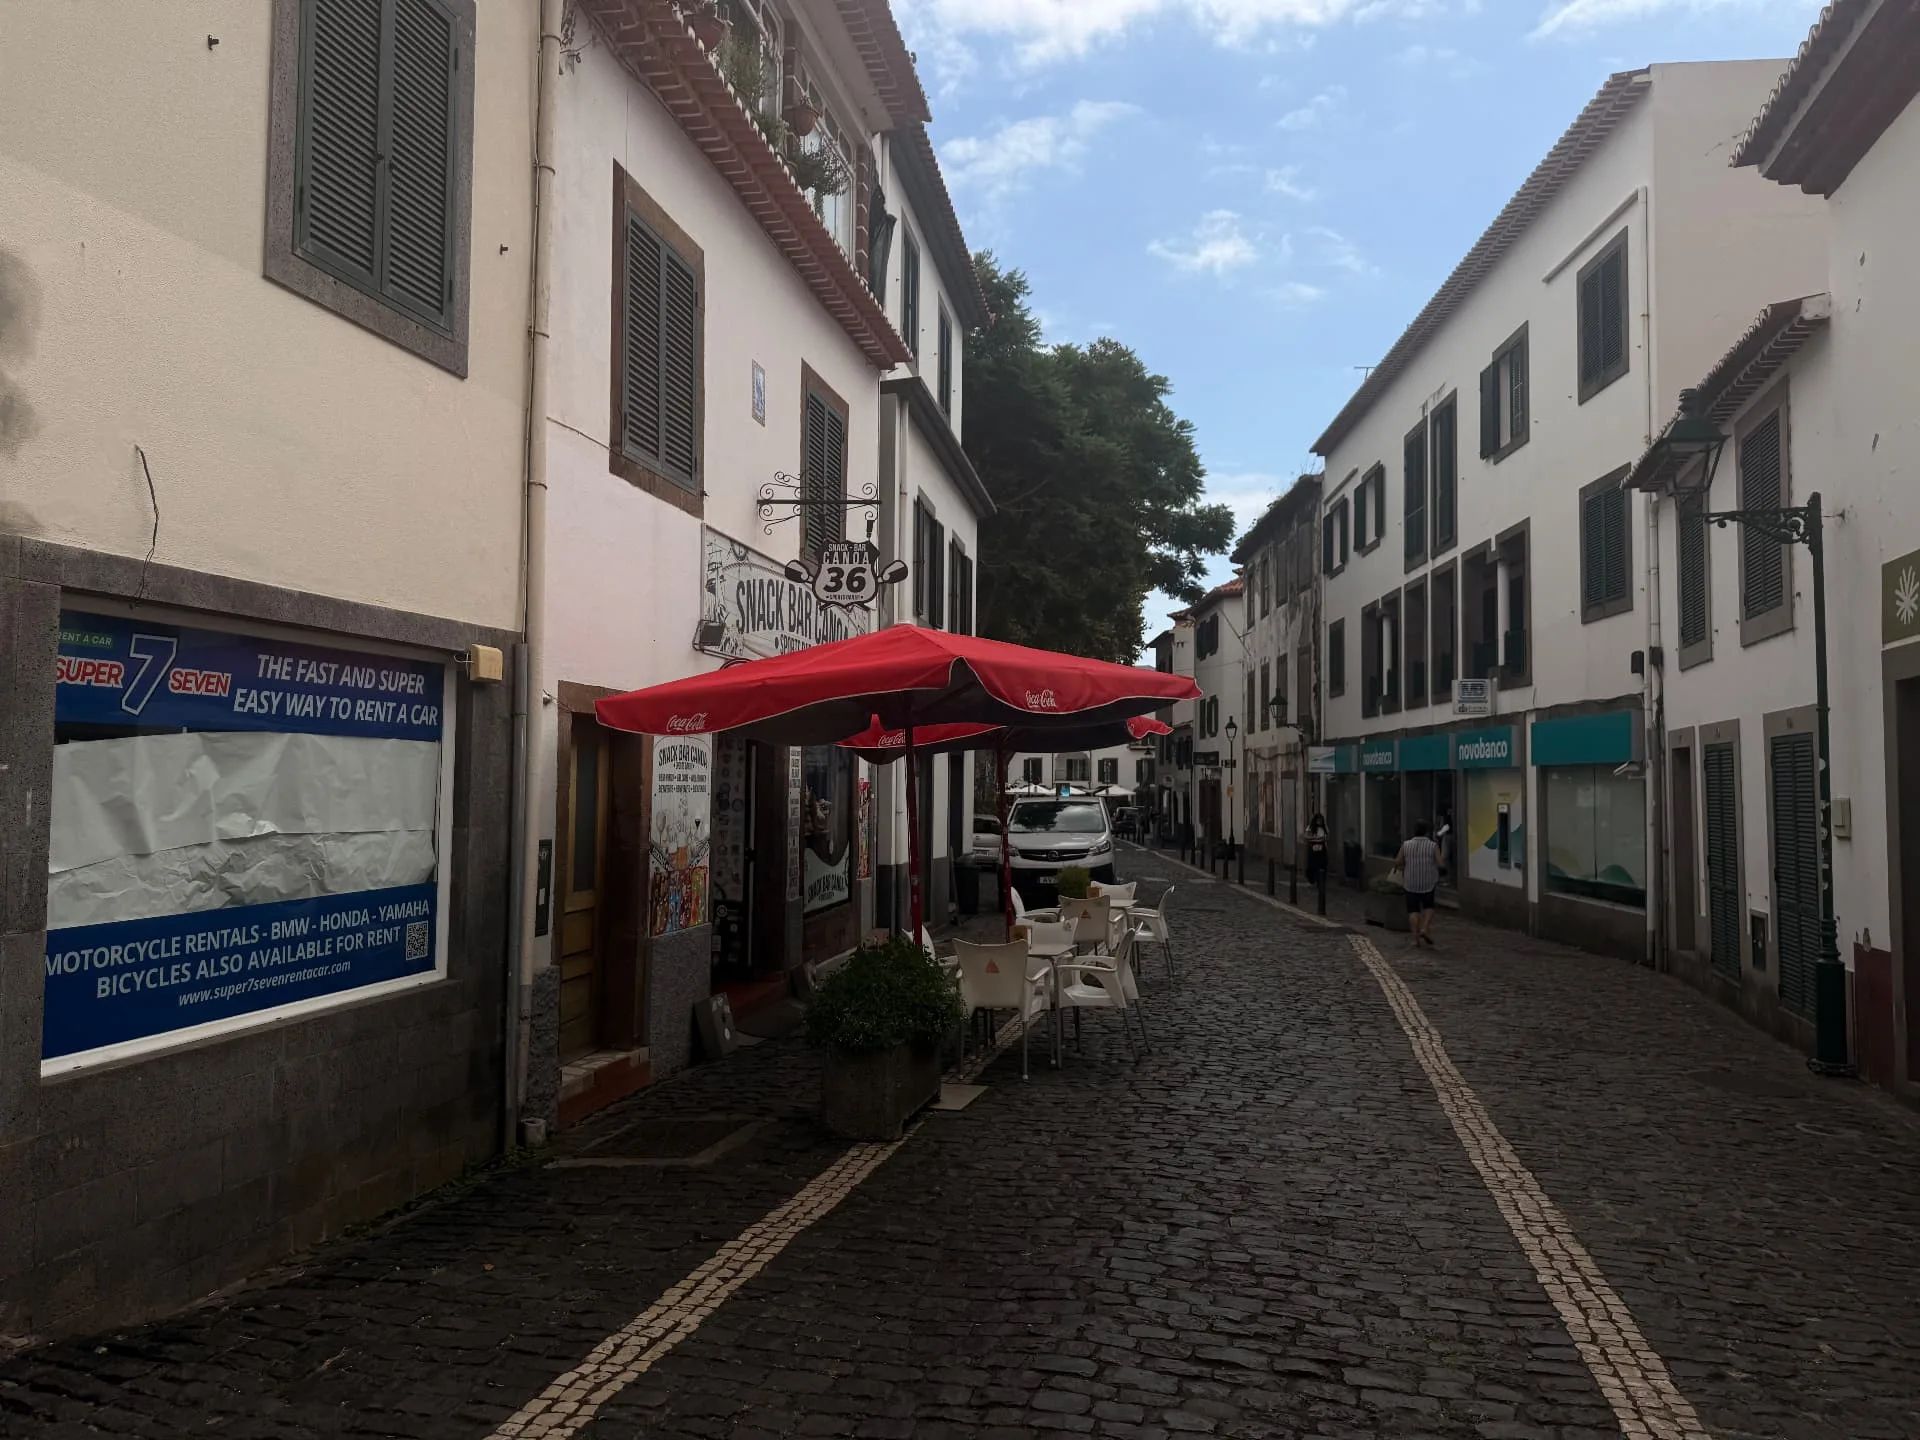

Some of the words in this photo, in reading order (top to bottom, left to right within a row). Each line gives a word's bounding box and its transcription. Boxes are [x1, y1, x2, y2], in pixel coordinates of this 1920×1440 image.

[823, 551, 869, 564] CANOA
[823, 566, 867, 593] 36
[736, 579, 784, 635] SNACK
[788, 583, 812, 640] BAR
[57, 631, 81, 642] RENT
[83, 634, 90, 642] A
[92, 635, 112, 646] CAR
[56, 656, 124, 688] SUPER
[122, 633, 178, 716] 7
[168, 667, 232, 697] SEVEN
[257, 654, 294, 681] THE
[295, 659, 339, 685] FAST
[339, 665, 376, 689] AND
[378, 669, 425, 695] SUPER
[233, 688, 283, 715] EASY
[285, 693, 327, 718] WAY
[329, 696, 351, 720] TO
[354, 700, 396, 723] RENT
[397, 703, 408, 724] A
[410, 704, 438, 726] CAR
[1025, 689, 1057, 708] Coca-Cola
[666, 712, 709, 732] Coca-Cola
[678, 744, 690, 761] BAR
[1458, 736, 1508, 760] novobanco
[45, 936, 181, 976] MOTORCYCLE
[185, 925, 260, 954] RENTALS
[271, 916, 310, 940] BMW
[320, 908, 370, 932] HONDA
[379, 899, 430, 922] YAMAHA
[96, 962, 192, 998] BICYCLES
[196, 953, 243, 980] ALSO
[247, 940, 332, 970] AVAILABLE
[336, 933, 364, 953] FOR
[367, 926, 400, 947] RENT
[179, 960, 351, 1006] www.super7sevenrentacar.com
